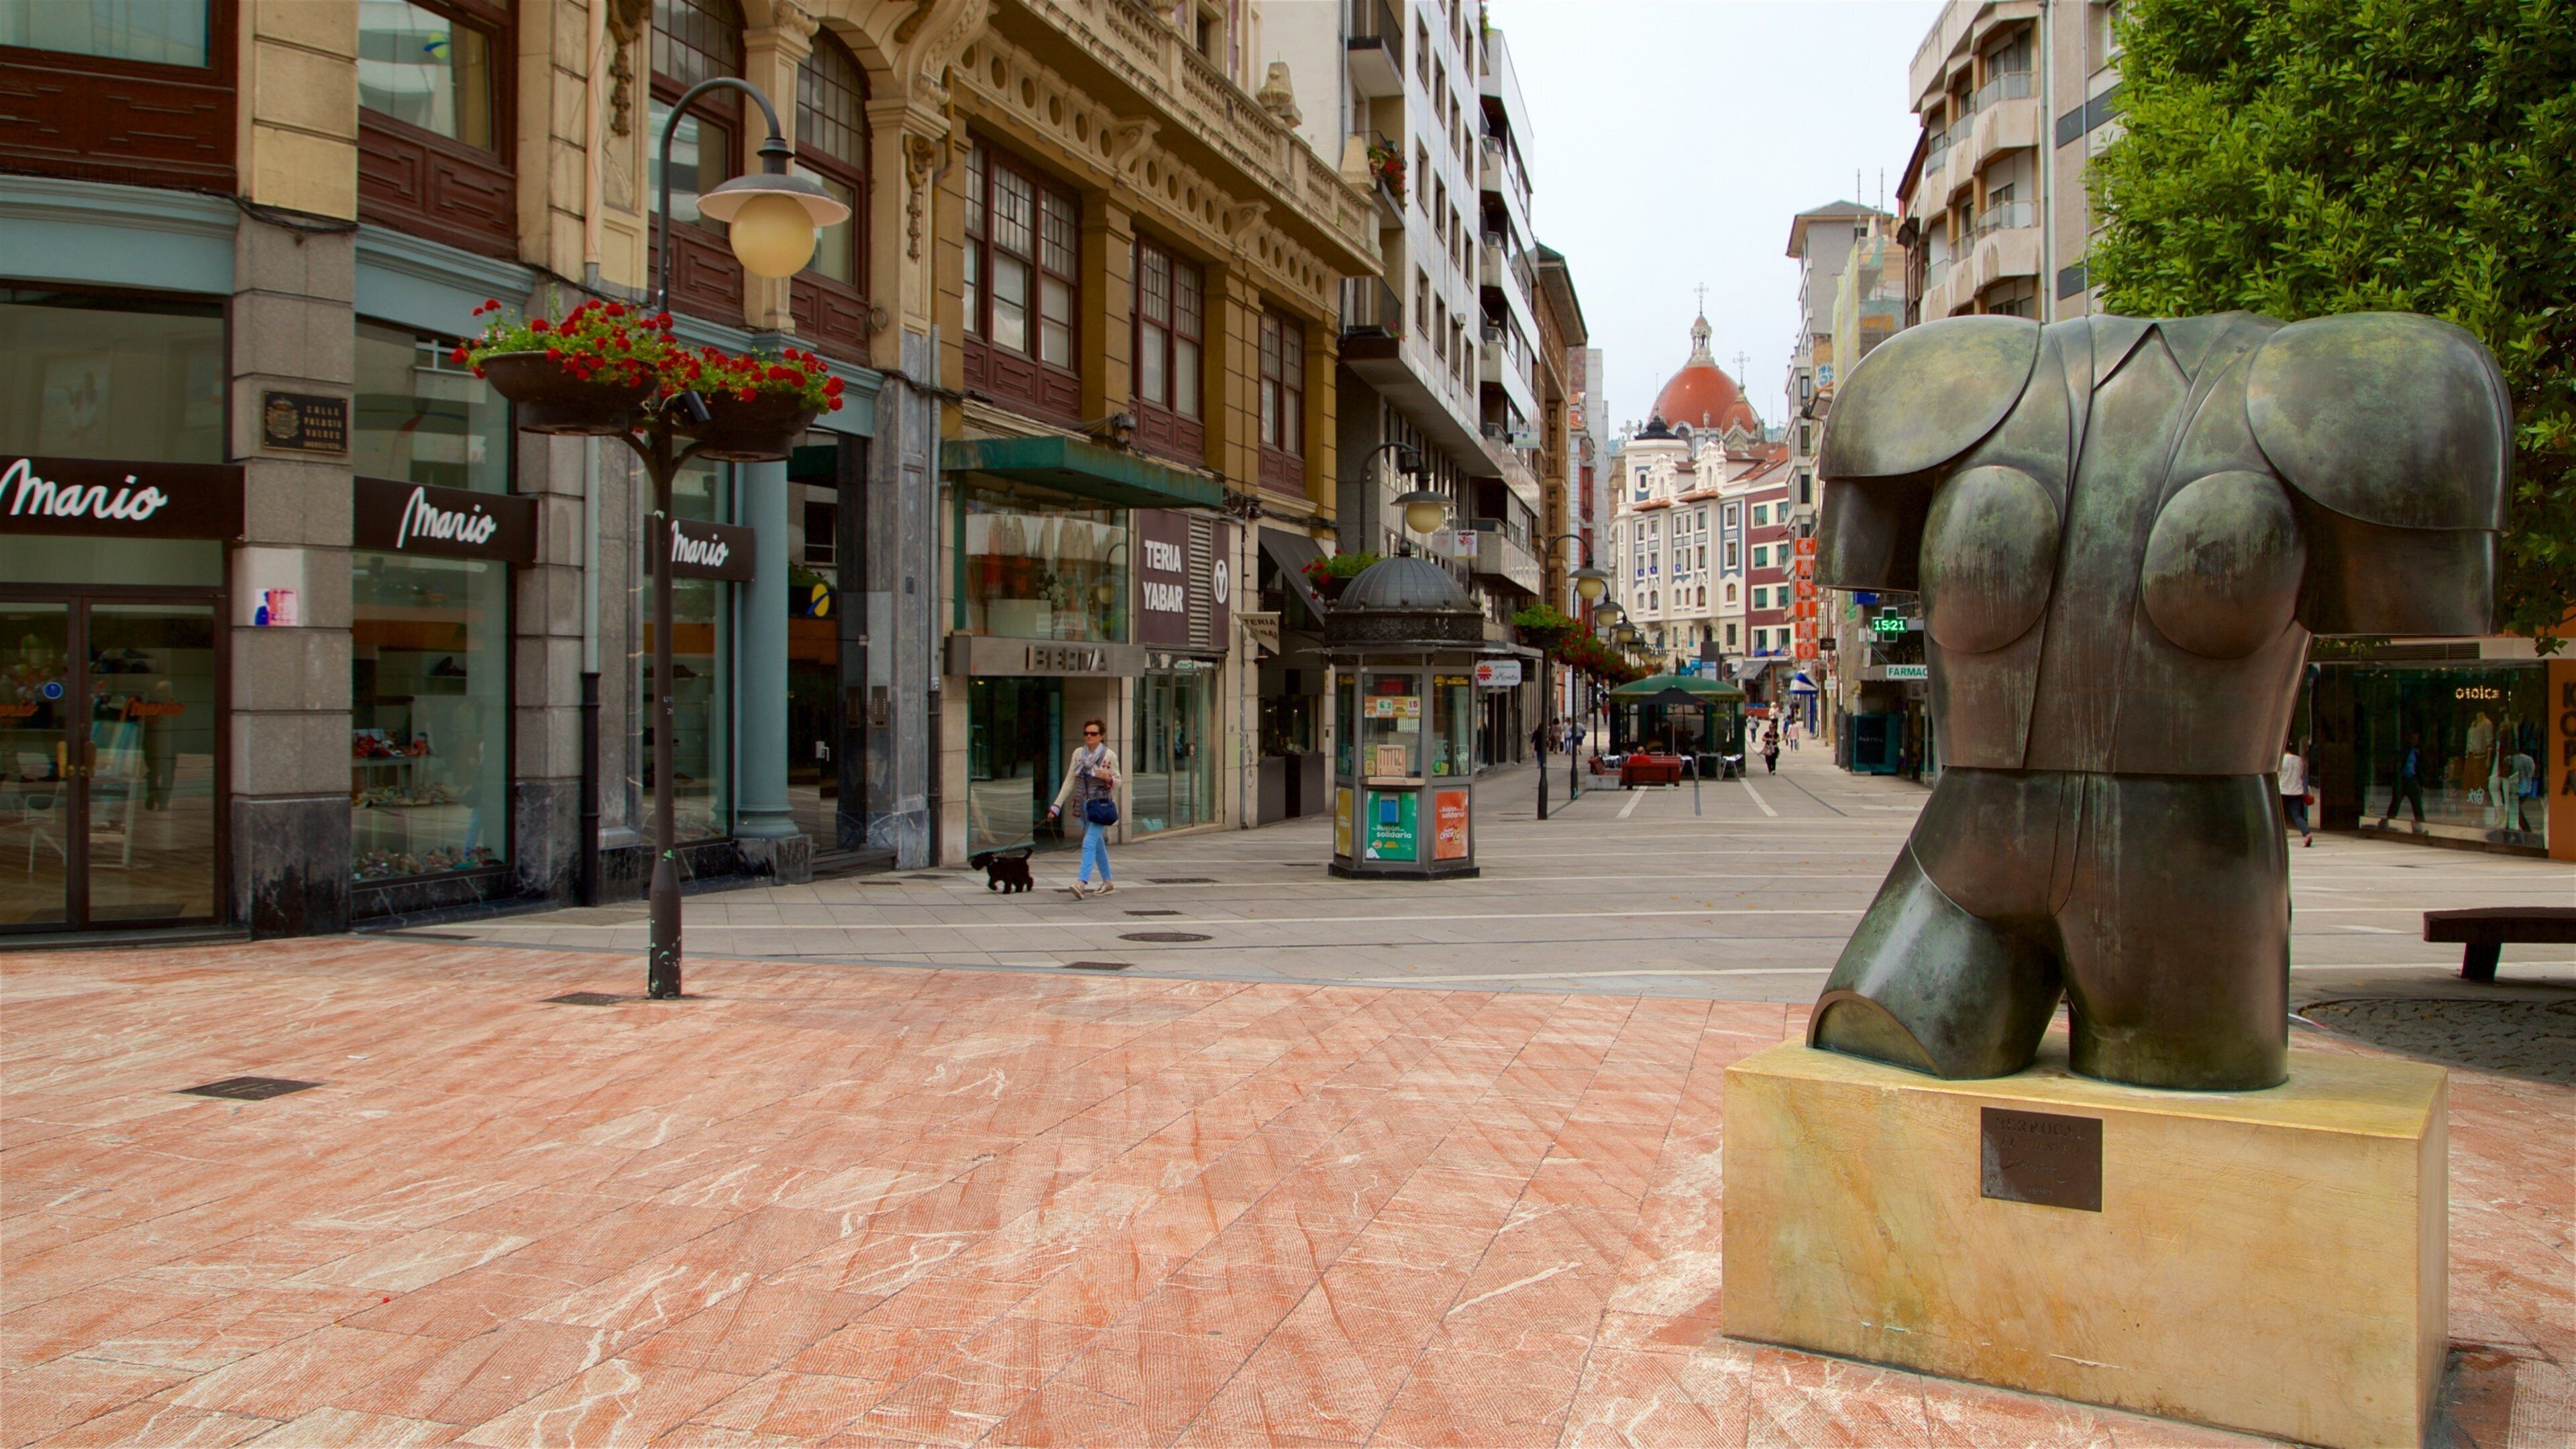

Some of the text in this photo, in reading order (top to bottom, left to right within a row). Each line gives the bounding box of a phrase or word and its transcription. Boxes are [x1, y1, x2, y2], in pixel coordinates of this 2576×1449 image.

[303, 417, 343, 429] PALACIO
[306, 405, 339, 416] CALLE
[0, 458, 168, 521] Mario
[396, 486, 496, 545] Mario
[672, 519, 729, 567] Mario
[1144, 539, 1182, 573] TERIA
[1142, 581, 1184, 613] YABAR
[1798, 538, 1815, 659] CASINO
[1242, 619, 1277, 627] TERIA
[1874, 620, 1906, 631] 15:21
[1025, 644, 1108, 672] IBERIA
[1996, 1117, 2086, 1140] BERROCAL
